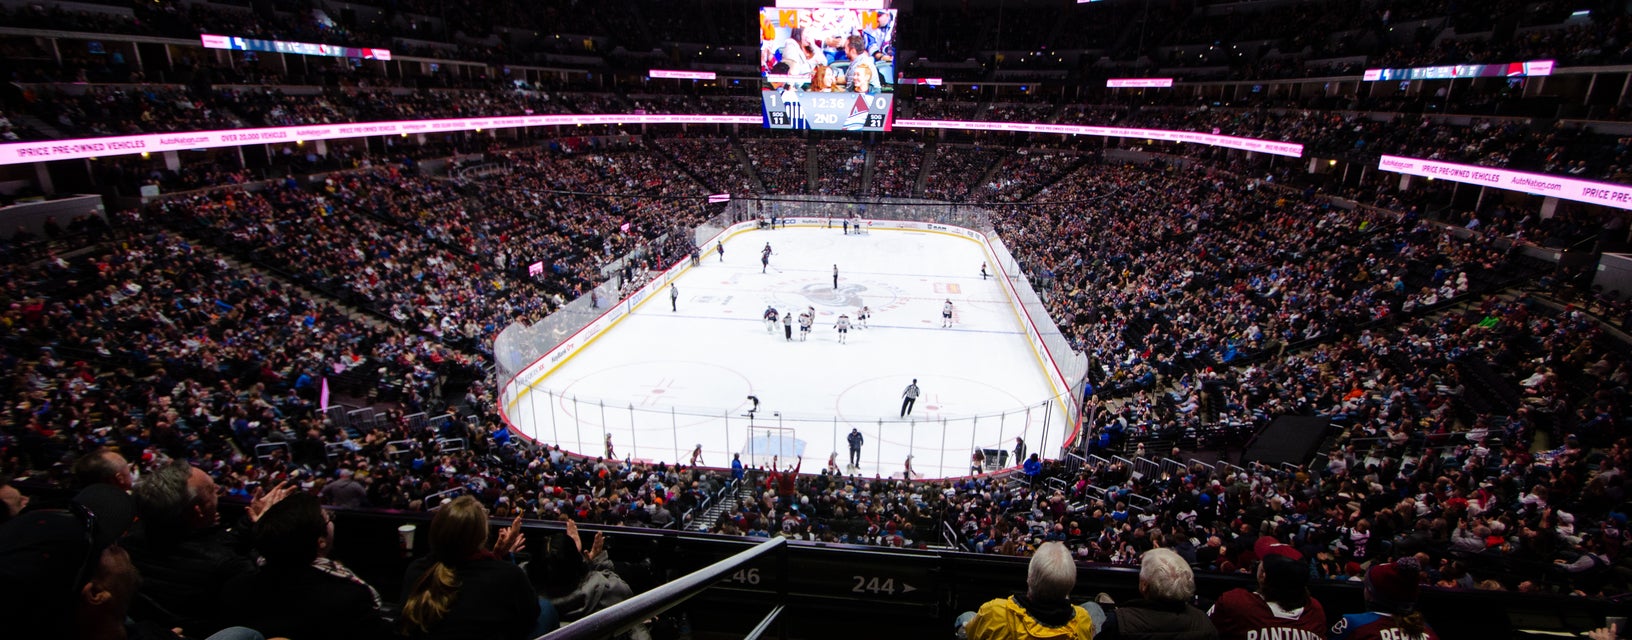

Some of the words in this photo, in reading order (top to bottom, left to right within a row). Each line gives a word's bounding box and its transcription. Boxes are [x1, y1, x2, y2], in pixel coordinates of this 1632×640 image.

[769, 94, 777, 107] 1
[811, 97, 845, 109] 12:36
[875, 97, 887, 110] 0
[774, 117, 784, 125] 11
[813, 113, 838, 124] 2ND
[870, 119, 881, 127] 21
[52, 143, 105, 154] PRE-OWNED
[107, 140, 146, 151] VEHICLES
[1439, 166, 1470, 178] PRE-OWNED
[1471, 171, 1500, 183] VEHICLES
[1511, 176, 1562, 191] AutoNation.com
[852, 575, 895, 594] 244
